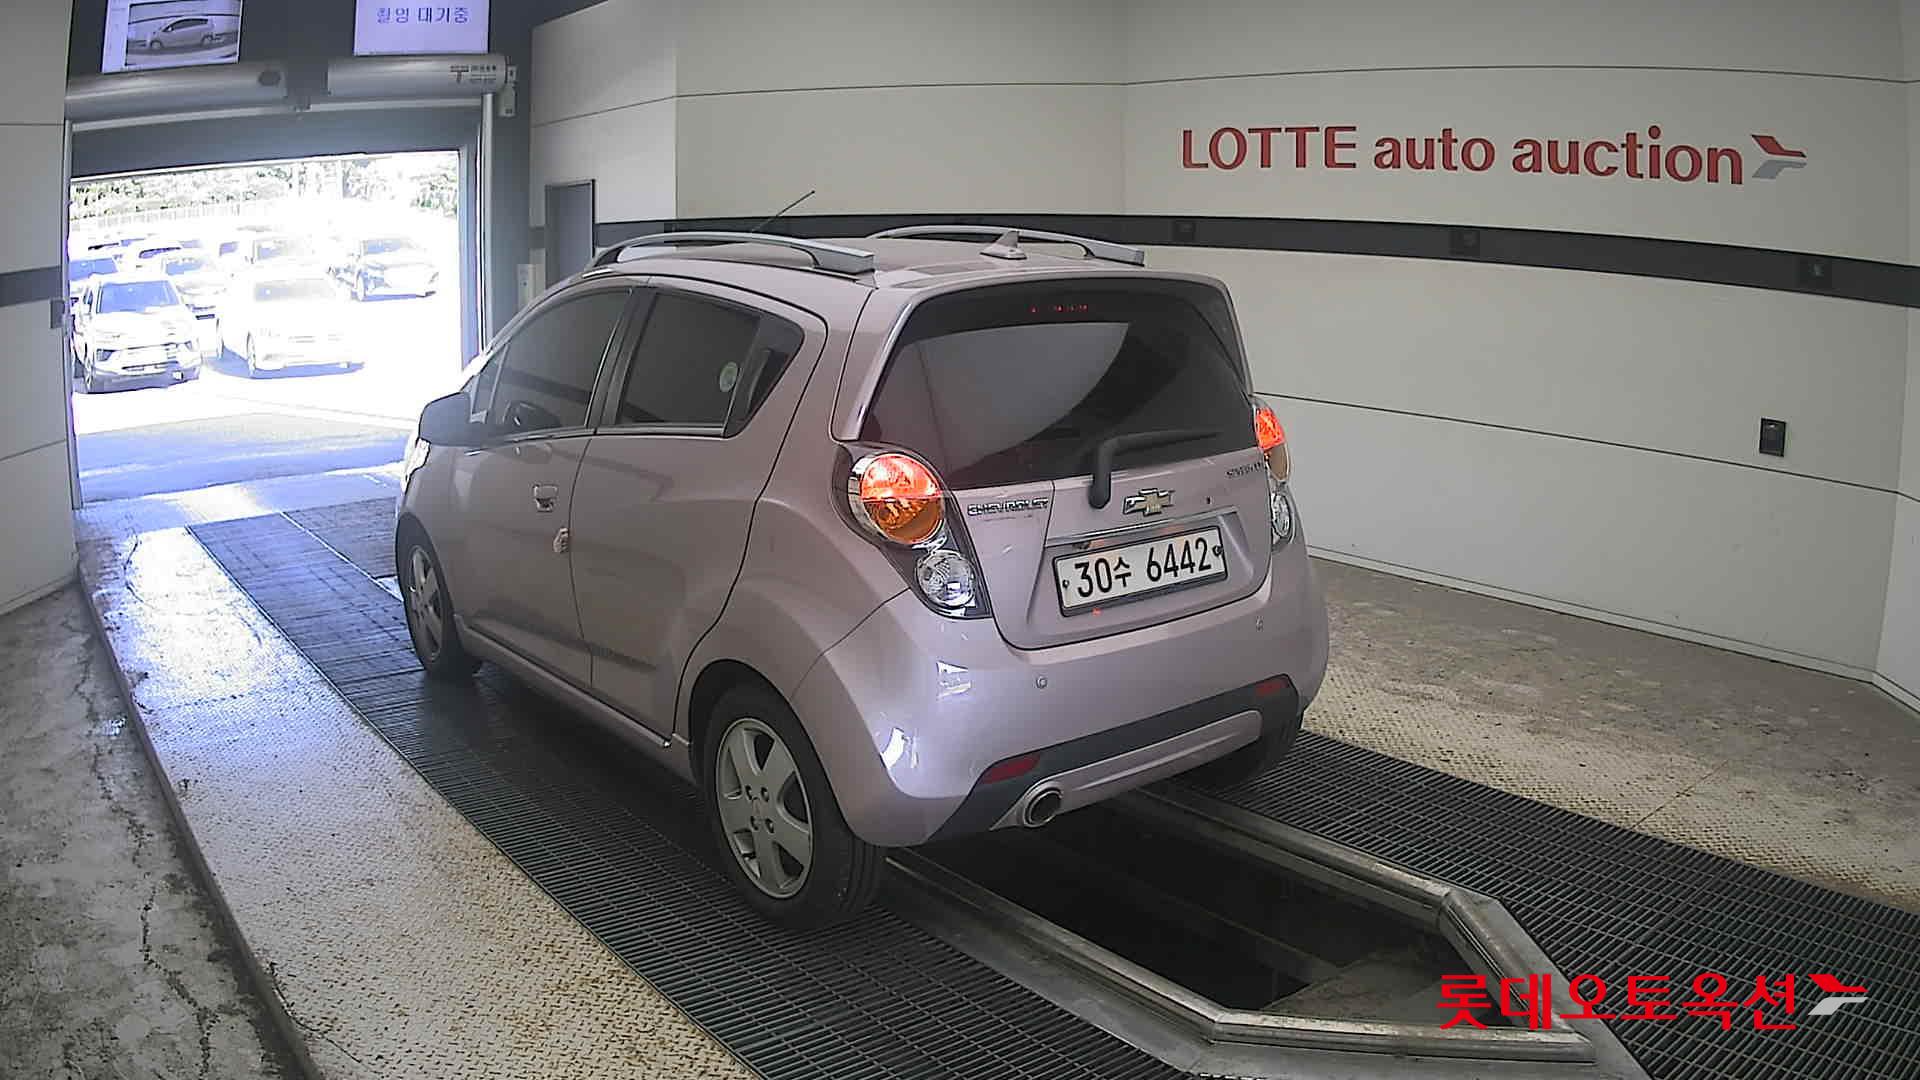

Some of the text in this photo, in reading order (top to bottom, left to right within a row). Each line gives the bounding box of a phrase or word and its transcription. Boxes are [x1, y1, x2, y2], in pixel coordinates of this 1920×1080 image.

[417, 7, 469, 24] 대기중
[1182, 125, 1743, 185] LOTTE auto auction
[1074, 537, 1212, 598] 30수 6442
